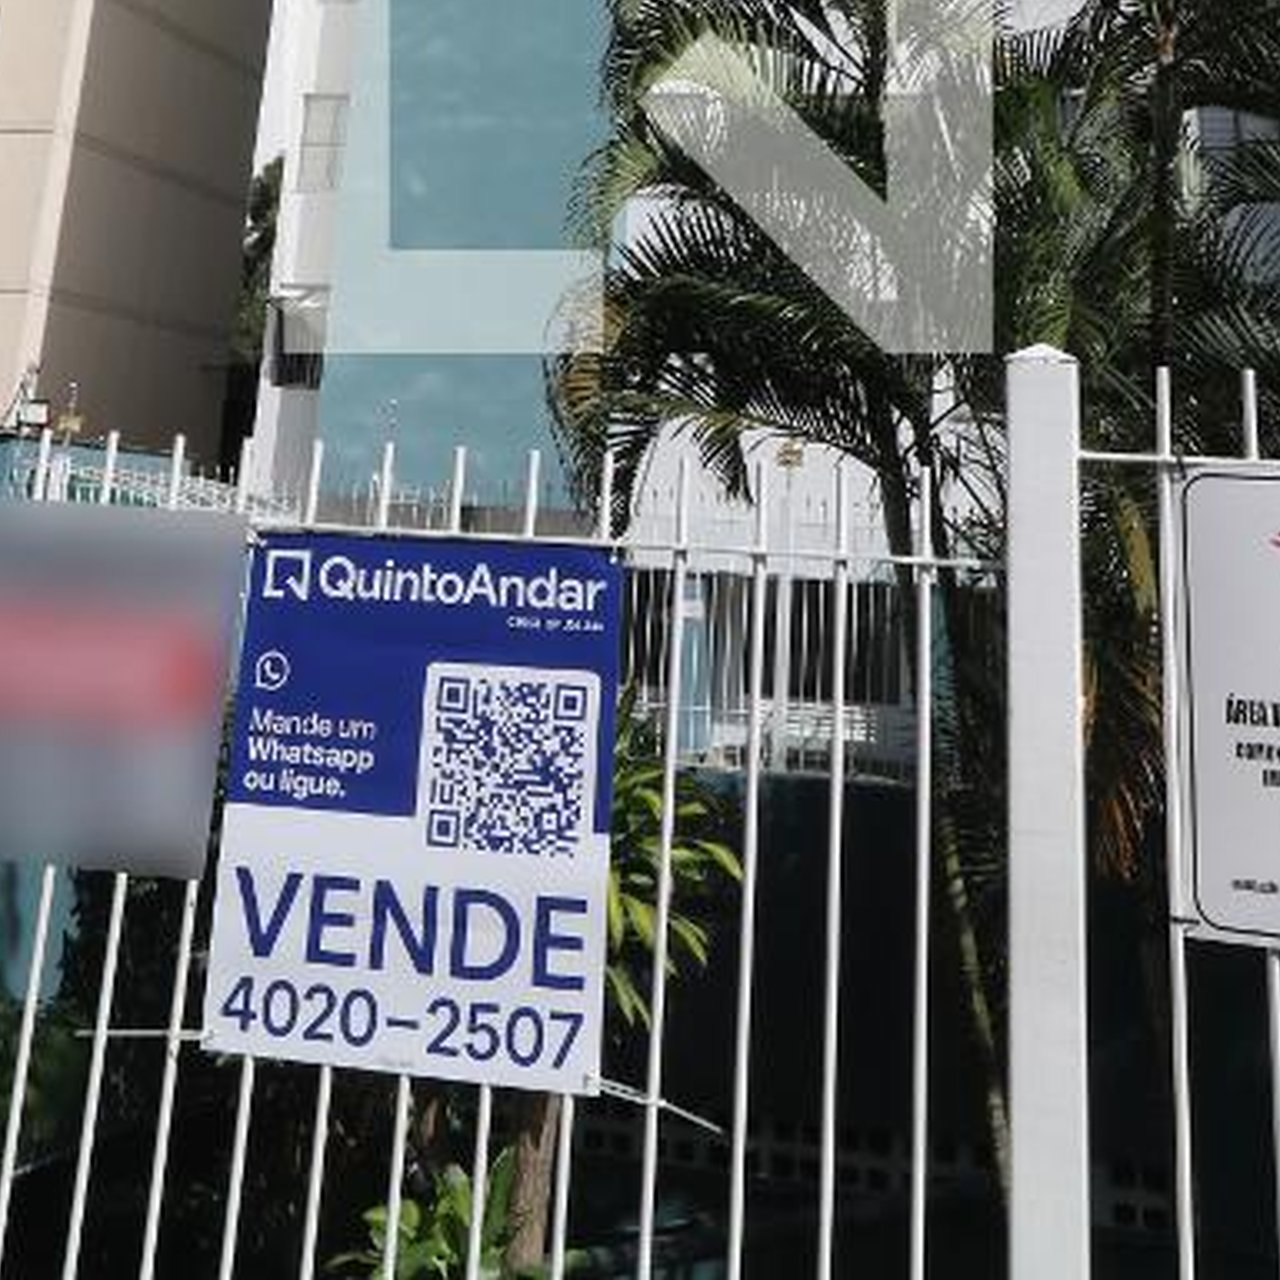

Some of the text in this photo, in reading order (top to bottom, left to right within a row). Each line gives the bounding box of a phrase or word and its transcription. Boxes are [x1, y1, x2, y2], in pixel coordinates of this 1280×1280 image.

[318, 554, 608, 612] QuintoAndar
[249, 706, 376, 741] Mande um
[247, 735, 376, 774] Whatsapp
[242, 767, 346, 801] ou ligue.
[235, 866, 588, 991] VENDE
[220, 976, 584, 1069] 4020-2507
